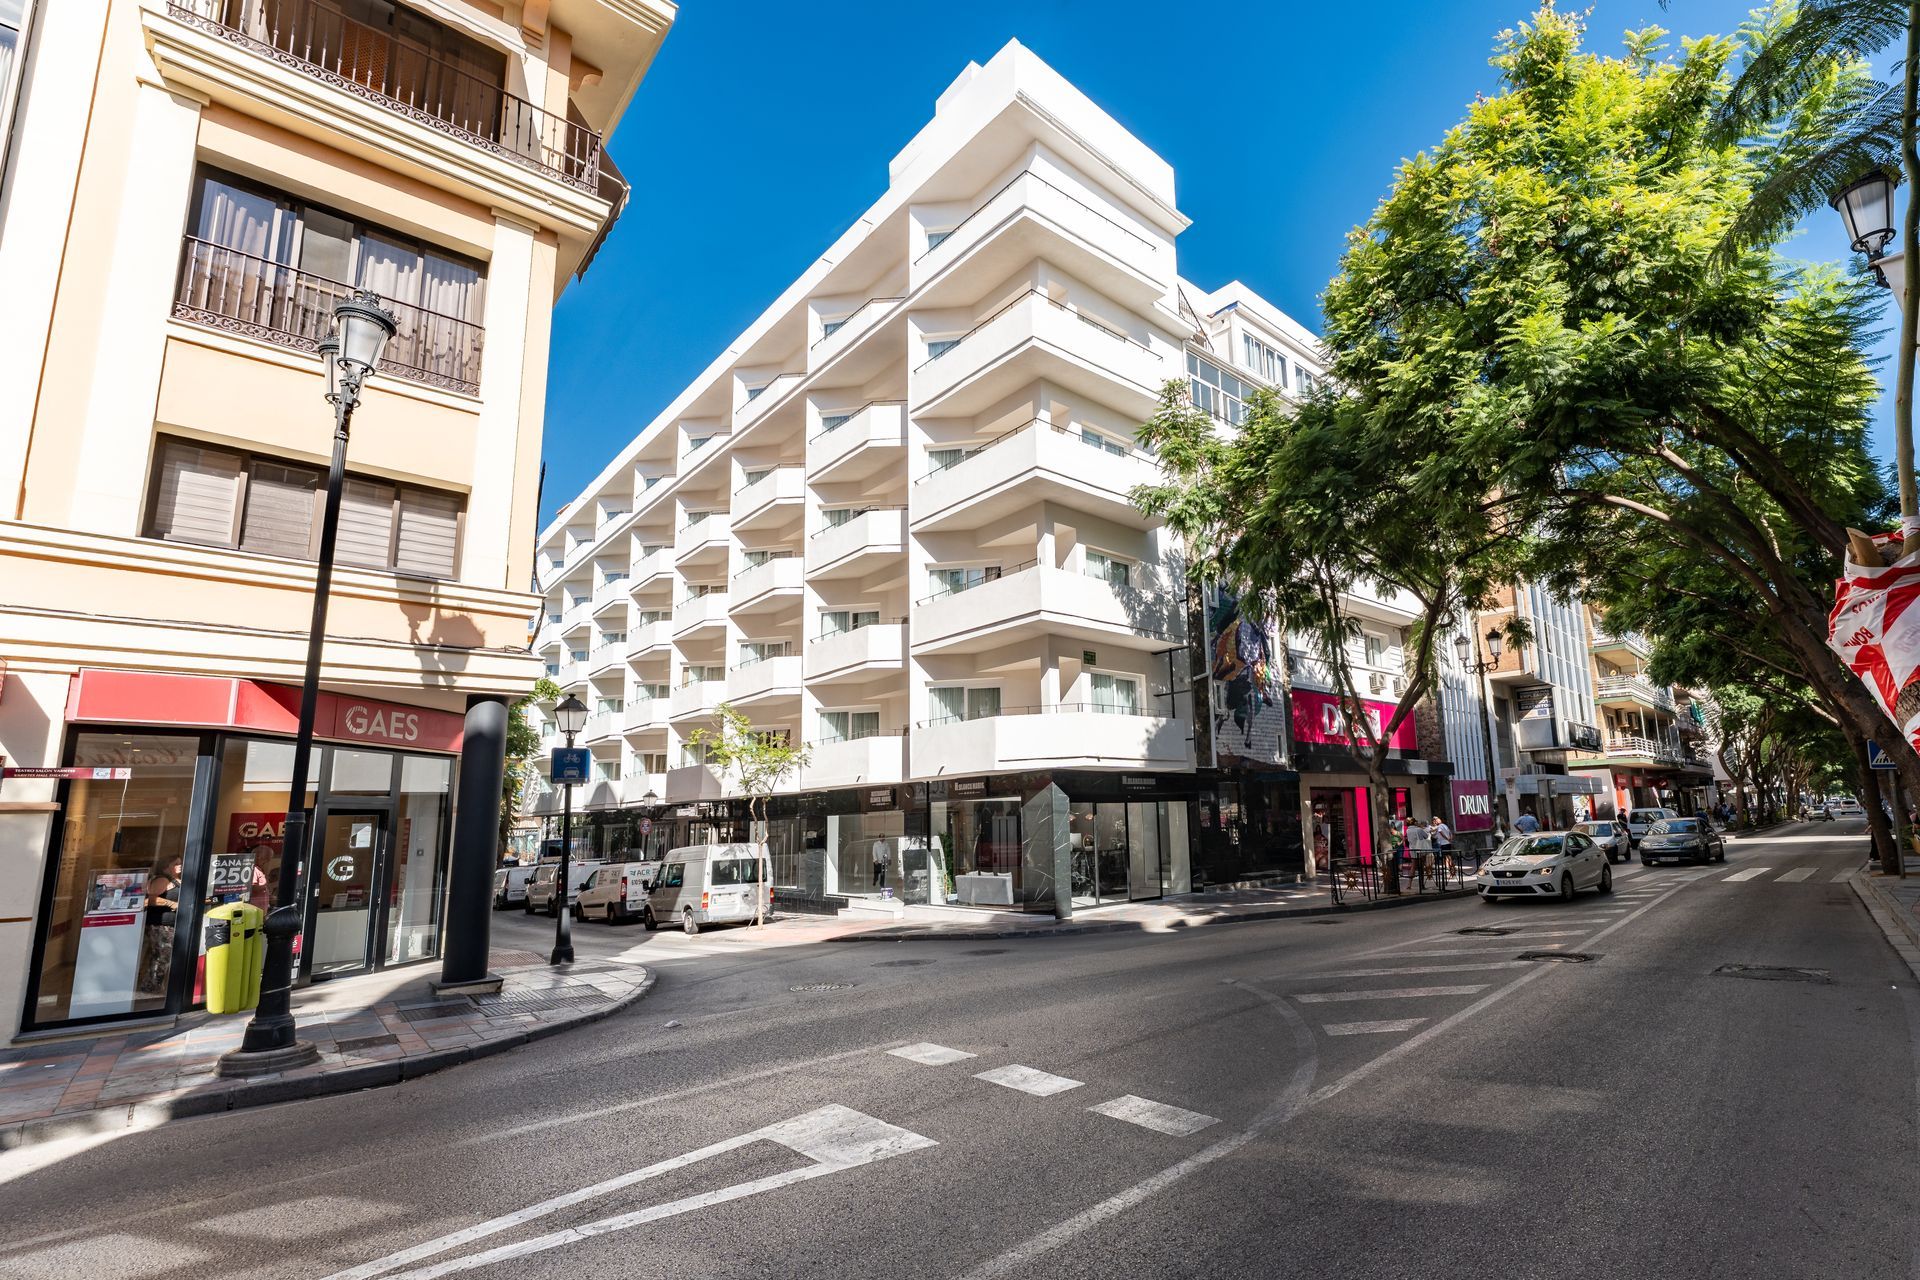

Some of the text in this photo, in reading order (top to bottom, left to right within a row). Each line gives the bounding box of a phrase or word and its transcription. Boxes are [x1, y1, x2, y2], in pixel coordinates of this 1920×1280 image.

[345, 705, 419, 741] GAES
[1459, 794, 1490, 816] DRUNI
[239, 821, 286, 838] GAE
[211, 859, 242, 867] GANA
[210, 866, 252, 885] 250
